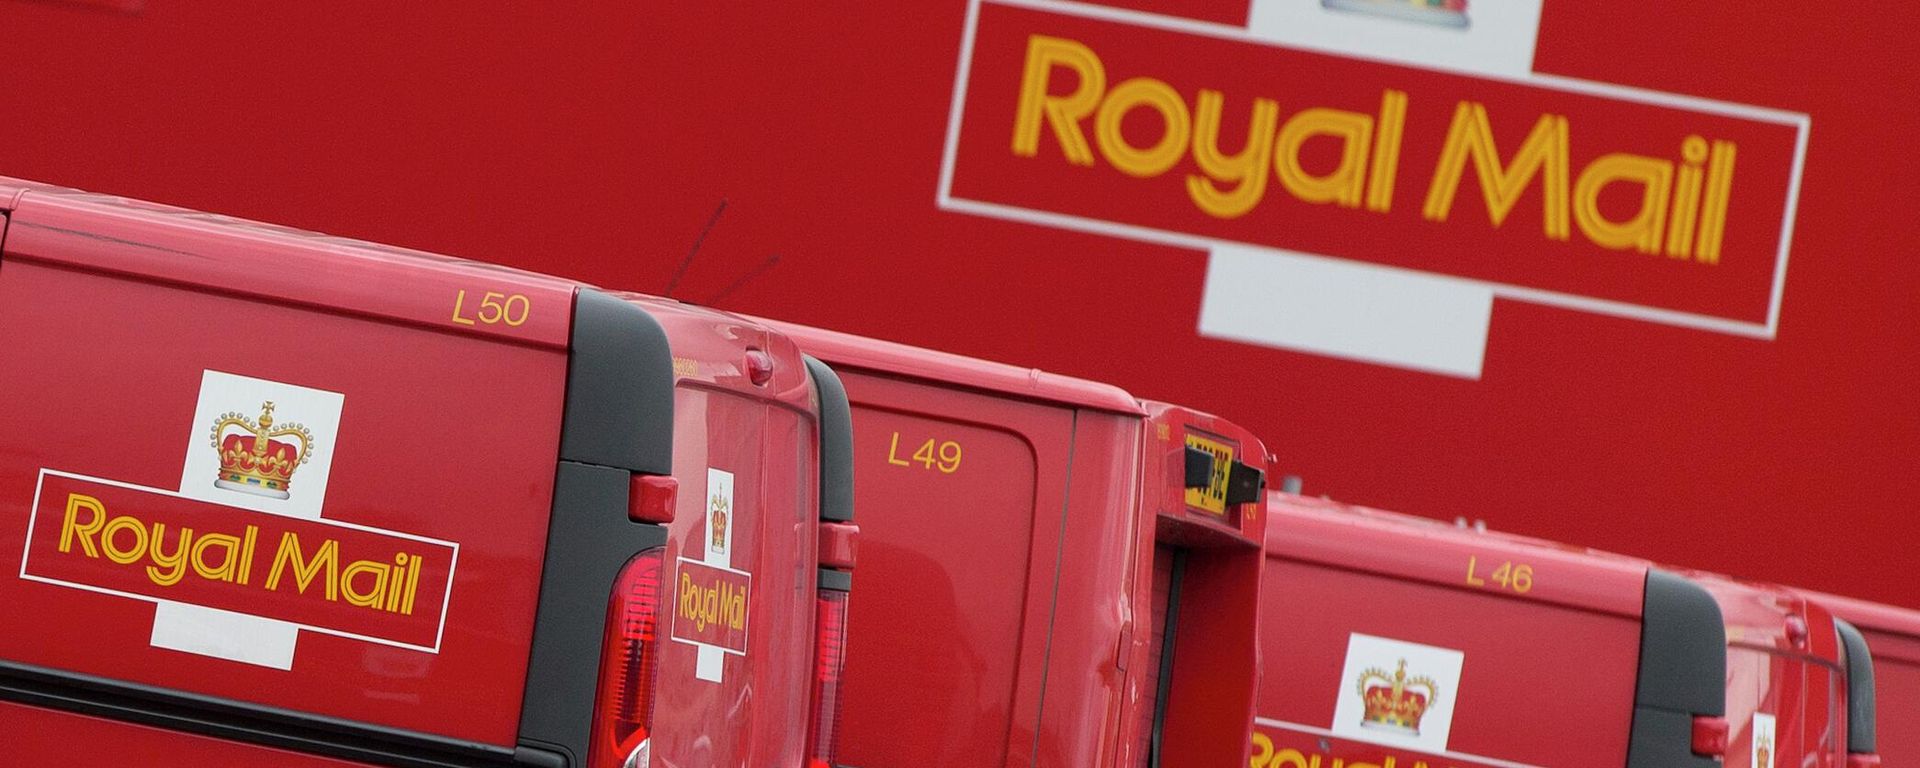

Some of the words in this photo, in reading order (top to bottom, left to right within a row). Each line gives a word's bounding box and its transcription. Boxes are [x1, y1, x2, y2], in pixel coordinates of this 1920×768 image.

[1013, 36, 1406, 218] Royal
[1424, 102, 1737, 263] Mail
[452, 289, 530, 327] L50
[888, 432, 962, 474] L49
[58, 493, 259, 587] Royal
[265, 531, 422, 616] Mail
[680, 571, 719, 633] Royal
[720, 579, 746, 631] Mail
